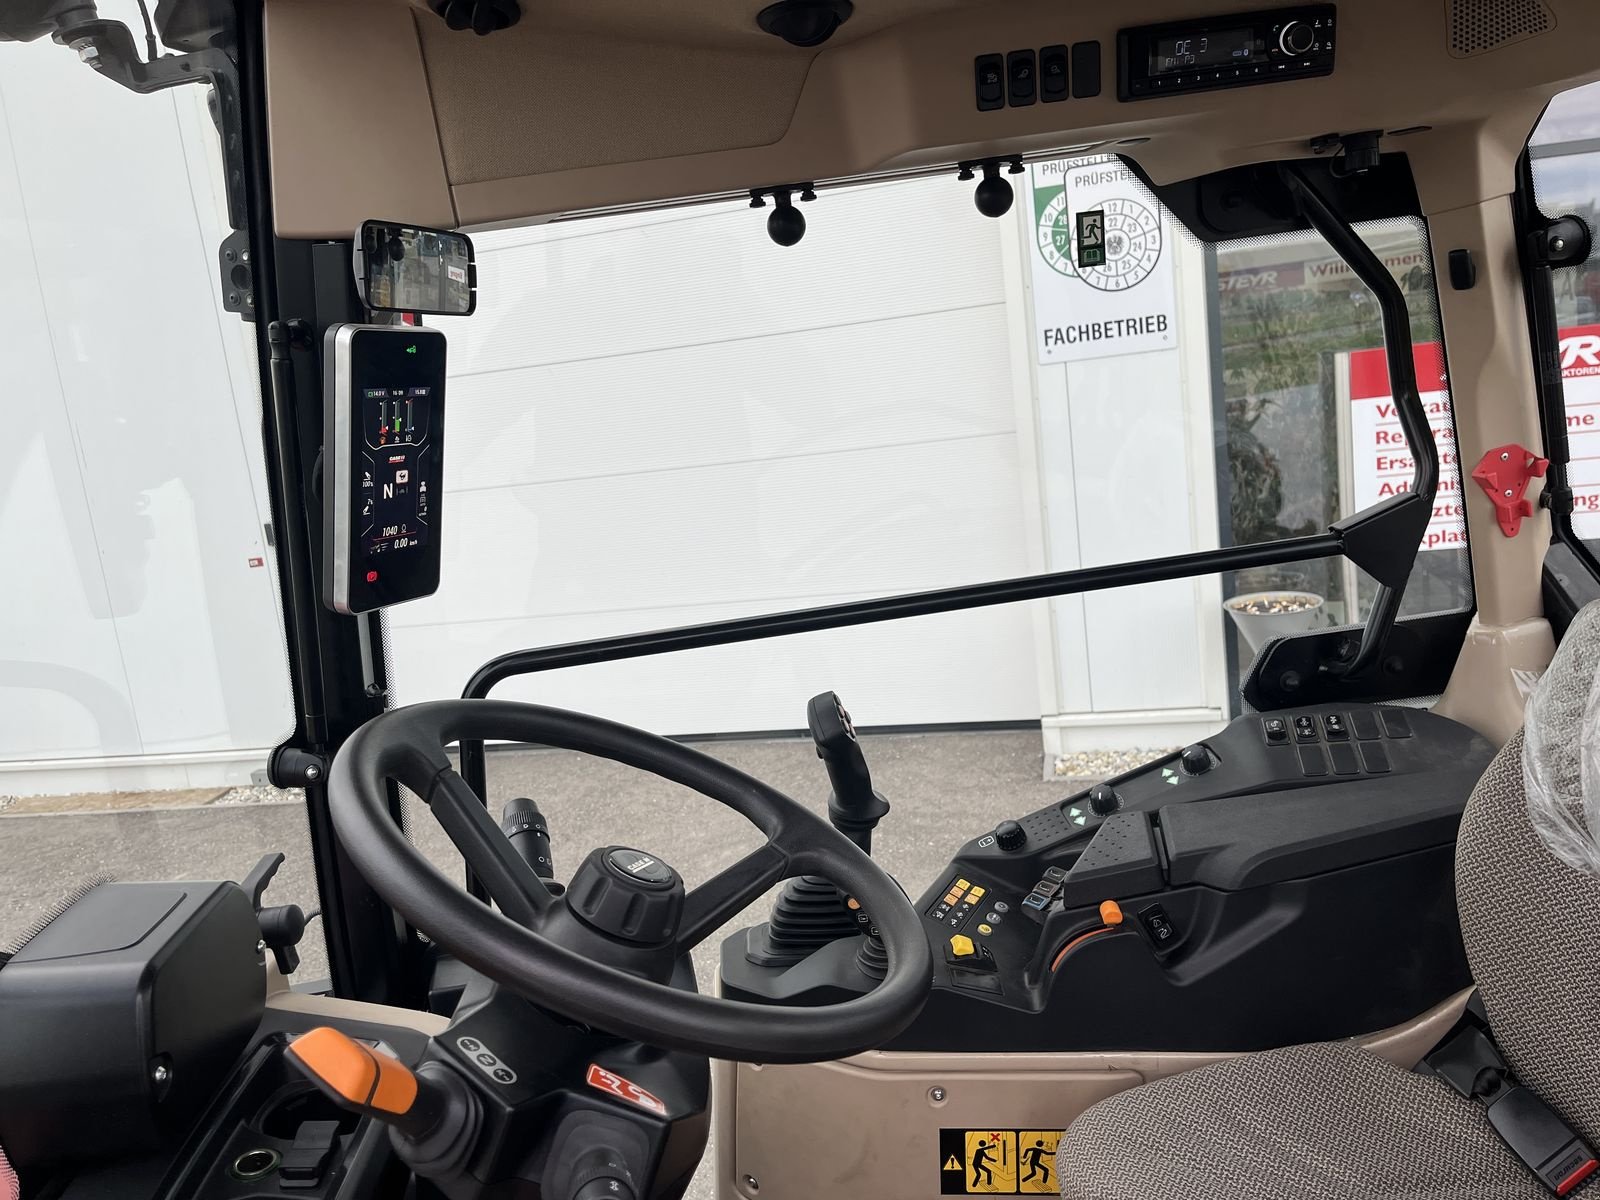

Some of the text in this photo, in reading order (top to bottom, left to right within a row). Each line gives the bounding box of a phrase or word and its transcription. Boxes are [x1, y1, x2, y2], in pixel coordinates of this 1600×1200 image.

[1107, 202, 1118, 213] 12
[1043, 213, 1053, 224] 10
[1108, 217, 1118, 228] 22
[1127, 222, 1137, 234] 23
[1055, 234, 1066, 246] 27
[1151, 235, 1157, 245] 3
[1132, 241, 1143, 252] 24
[1122, 259, 1131, 270] 25
[1043, 314, 1168, 347] FACHBETRIEB
[383, 482, 394, 500] N
[382, 525, 398, 537] 1040
[394, 537, 408, 549] 0.00
